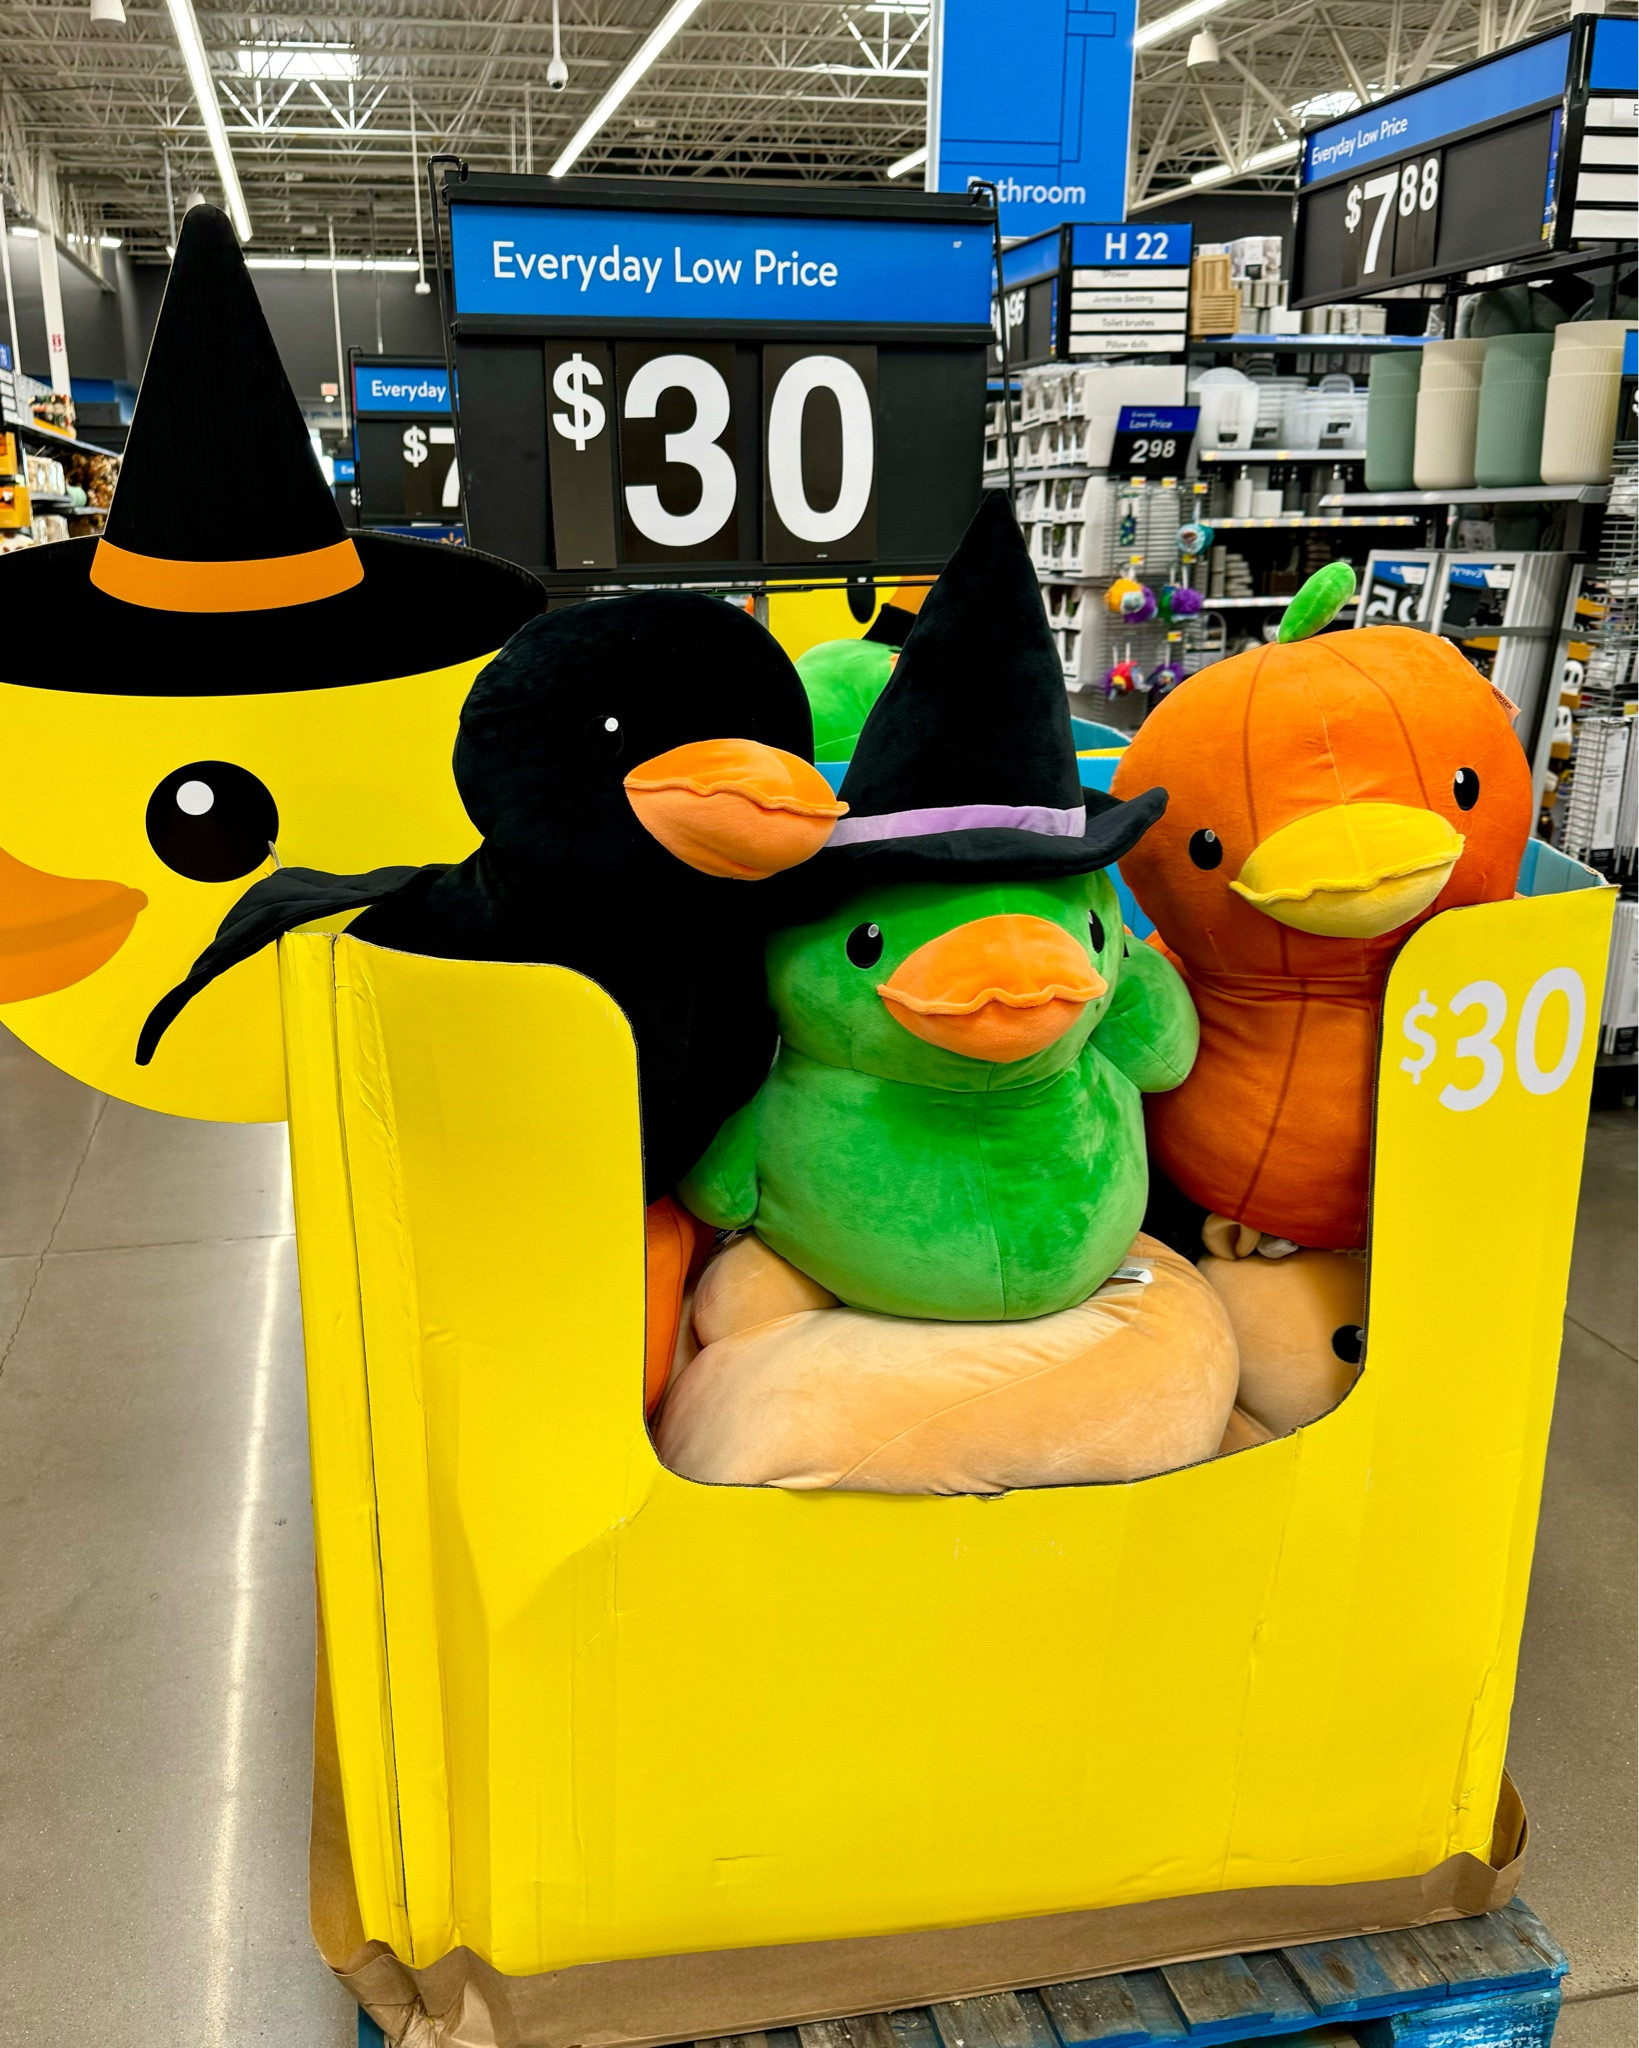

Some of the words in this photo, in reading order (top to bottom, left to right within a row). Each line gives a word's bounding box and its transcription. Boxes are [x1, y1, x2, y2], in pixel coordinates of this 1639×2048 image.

[1311, 136, 1355, 166] Everyday
[1357, 129, 1379, 149] Low
[1380, 117, 1409, 141] Price
[967, 175, 1086, 205] throom
[1104, 232, 1127, 260] H
[1134, 231, 1169, 260] 22
[492, 241, 663, 294] Everyday
[674, 246, 743, 286] Low
[754, 249, 839, 288] Price
[1101, 318, 1123, 327] Toilet
[1124, 317, 1155, 327] brushes
[371, 379, 447, 403] Everyday
[1129, 420, 1148, 429] Low
[1149, 420, 1173, 429] Price
[552, 352, 875, 548] $30
[1129, 438, 1176, 464] 298
[1399, 966, 1587, 1112] $30
